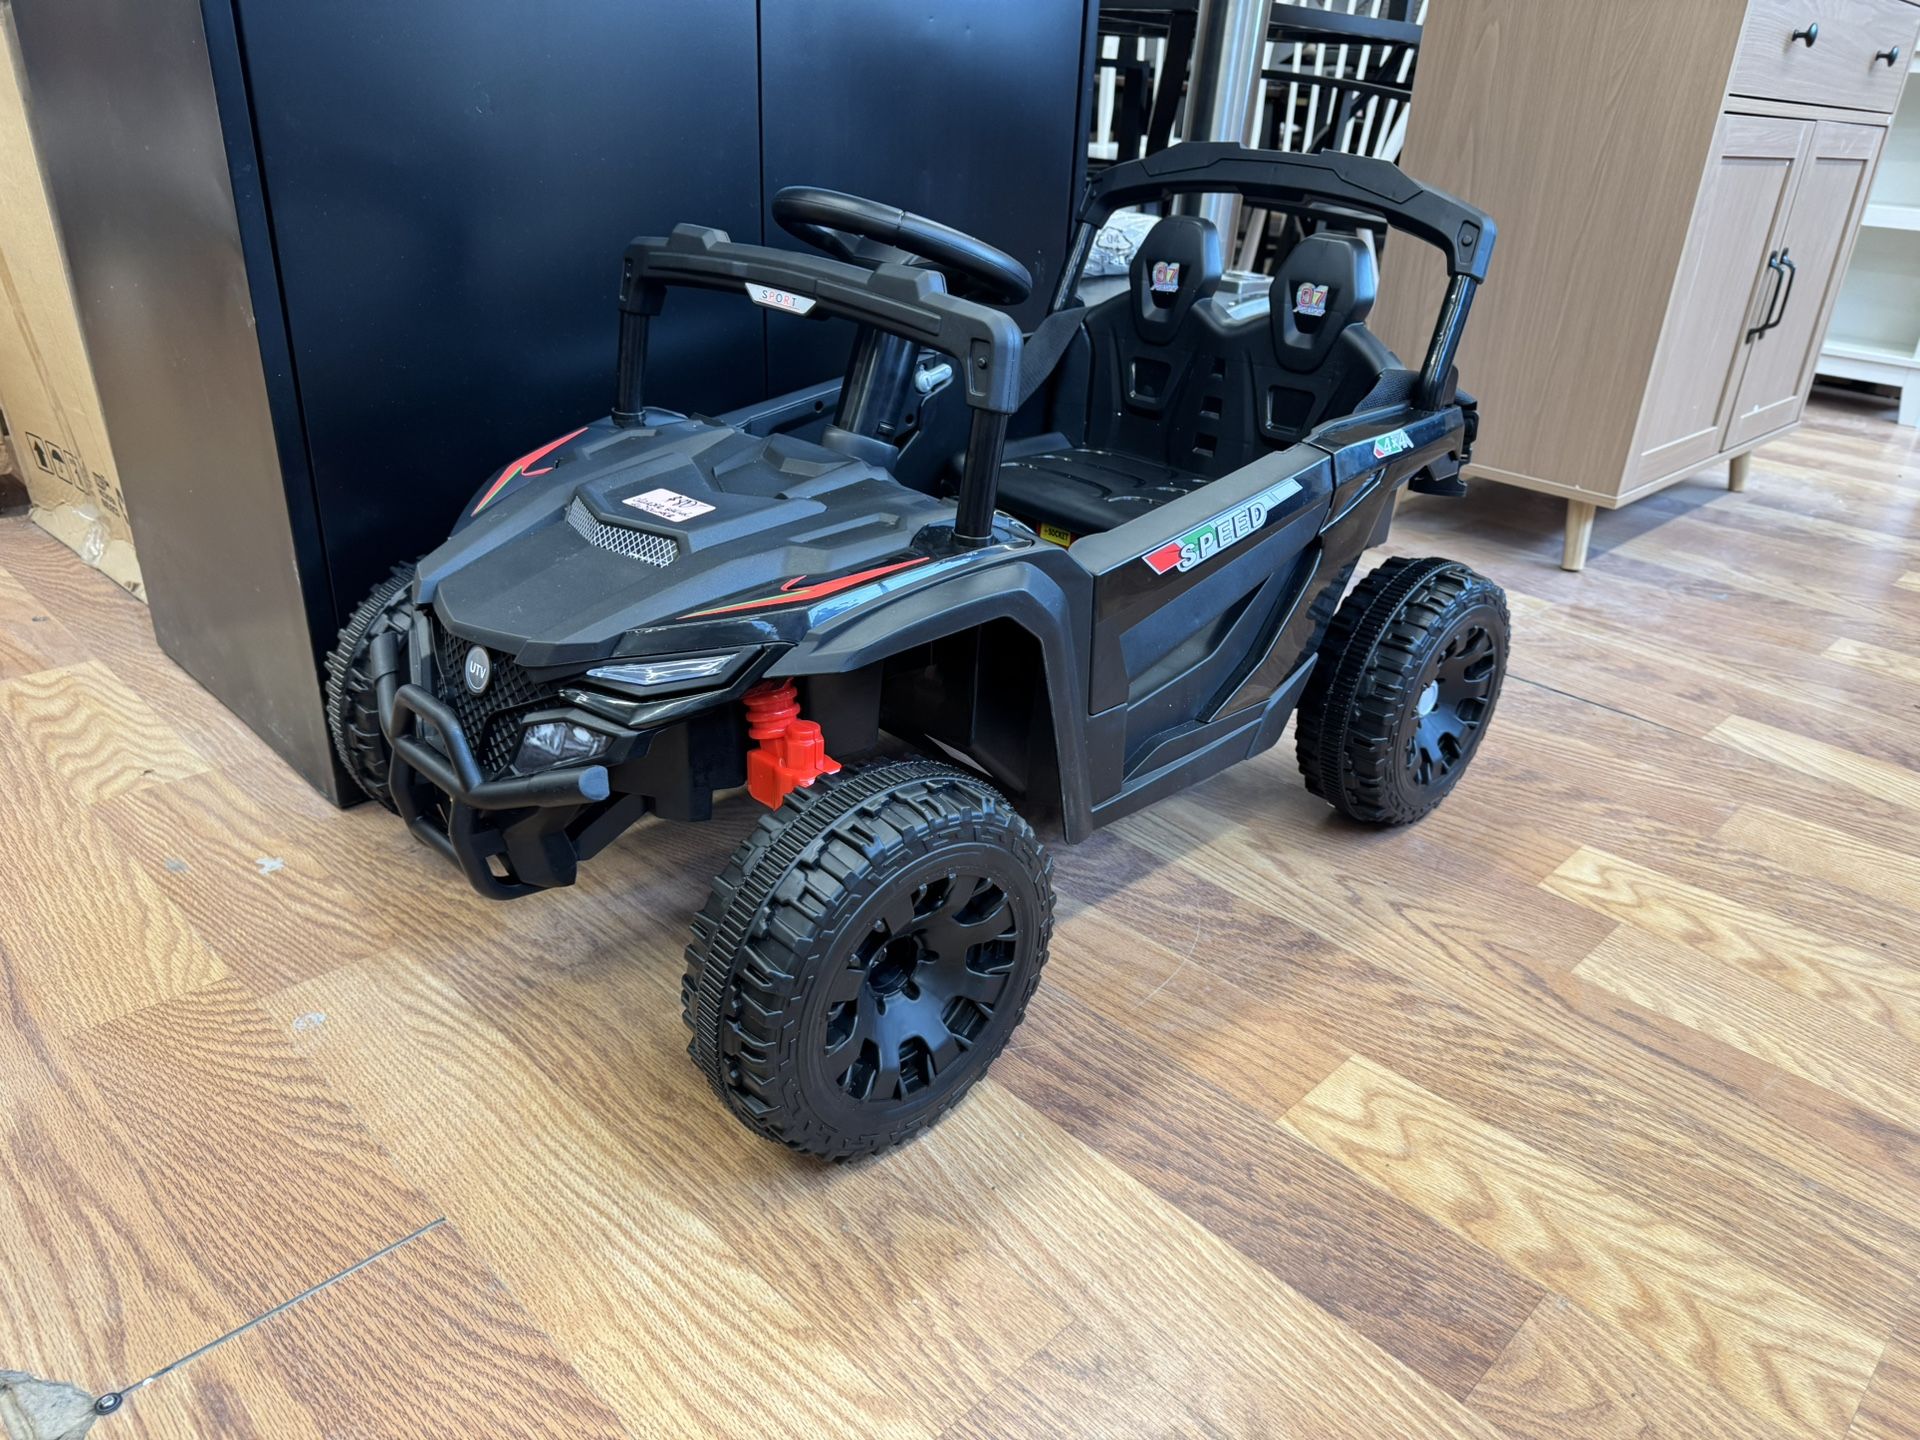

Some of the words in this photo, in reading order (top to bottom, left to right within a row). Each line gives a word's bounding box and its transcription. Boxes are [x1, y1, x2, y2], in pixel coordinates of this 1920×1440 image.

[762, 290, 797, 307] SPORT
[1177, 502, 1267, 569] SPEED
[470, 660, 487, 679] UTV
